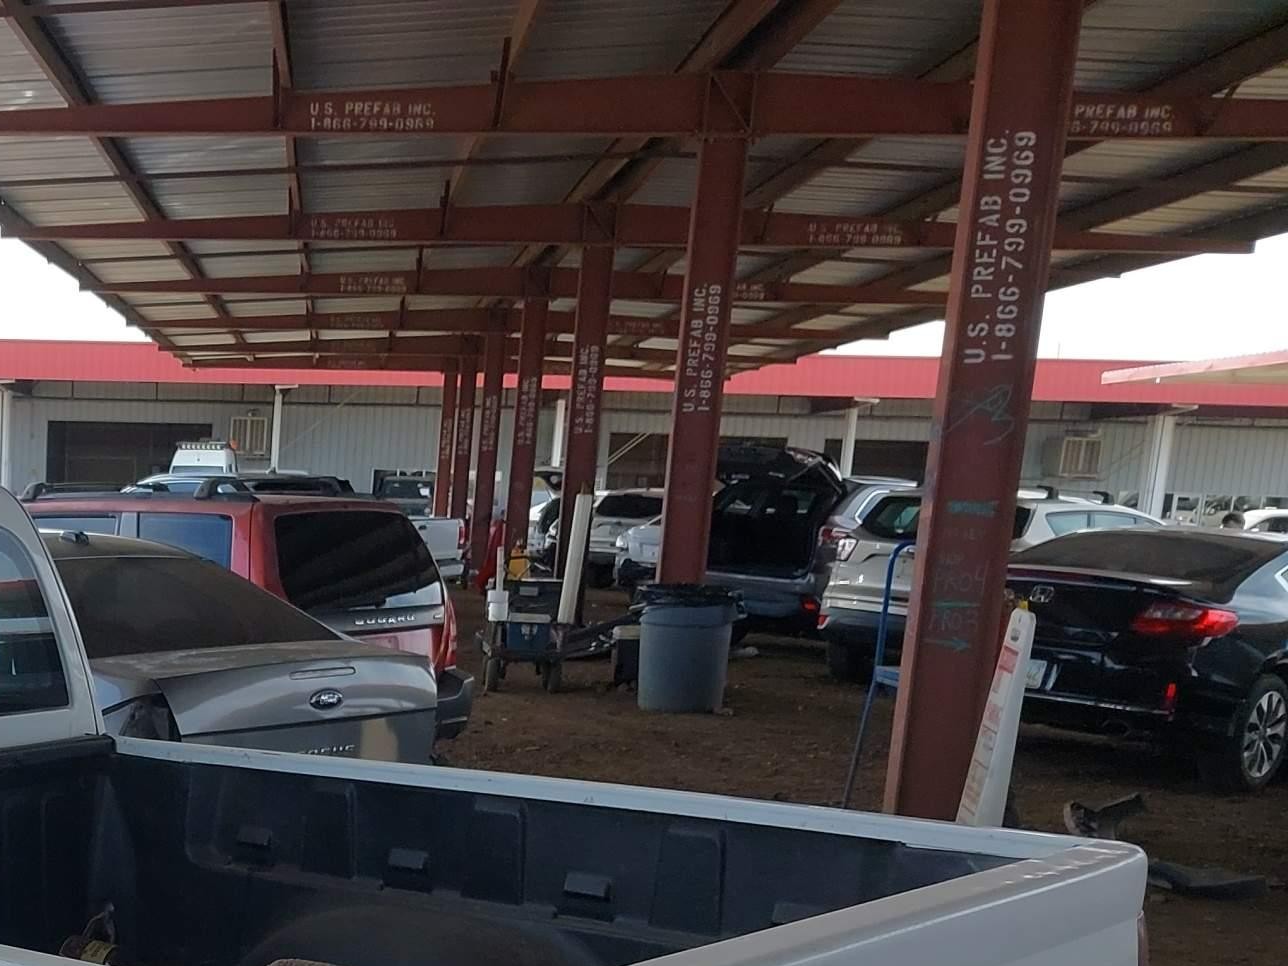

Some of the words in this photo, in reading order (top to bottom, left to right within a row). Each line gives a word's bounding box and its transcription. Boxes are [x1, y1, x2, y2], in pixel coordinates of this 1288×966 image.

[310, 102, 337, 115] U.S.
[345, 101, 401, 115] PREFAB
[408, 102, 436, 115] INC.
[1074, 104, 1137, 119] PREFAB
[984, 128, 1009, 181] INC.
[971, 195, 1001, 299] PREFAB
[991, 131, 1037, 361] 1-866-799-0969
[692, 282, 708, 312] INC.
[686, 319, 704, 377] PREFAB
[697, 284, 722, 412] 1-866-799-0969
[964, 314, 990, 364] U.S.
[681, 384, 698, 413] U.S.
